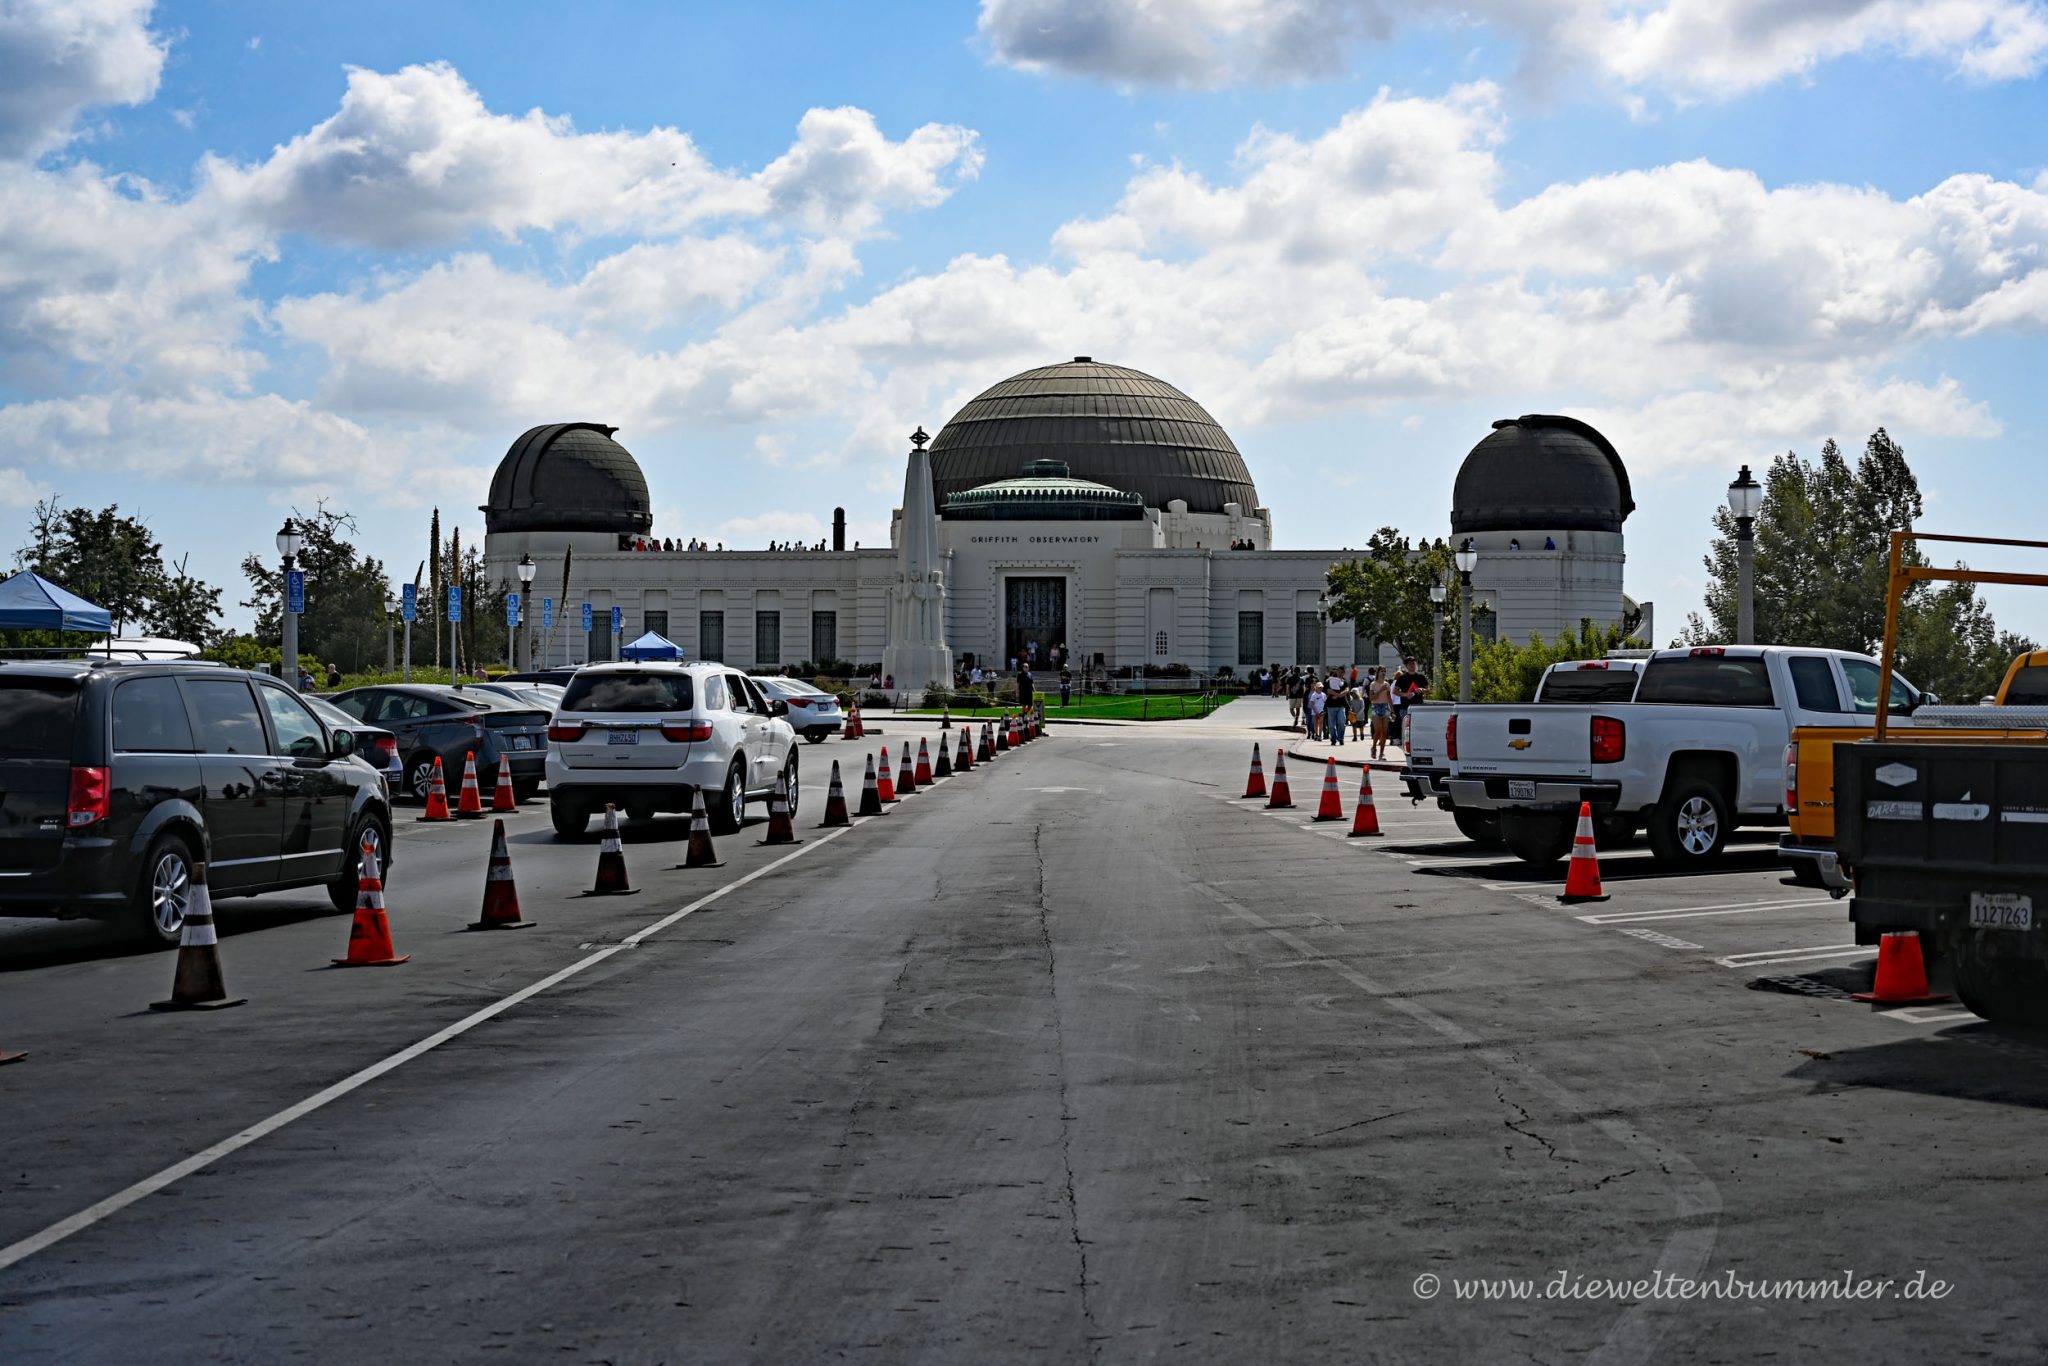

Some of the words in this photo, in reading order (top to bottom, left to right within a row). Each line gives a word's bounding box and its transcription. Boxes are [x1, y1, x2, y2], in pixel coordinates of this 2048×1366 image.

[971, 535, 1018, 544] GRIFFITH
[1028, 535, 1099, 544] OBSERVATORY
[1867, 803, 1897, 818] DARE
[1974, 904, 2029, 926] 1127263
